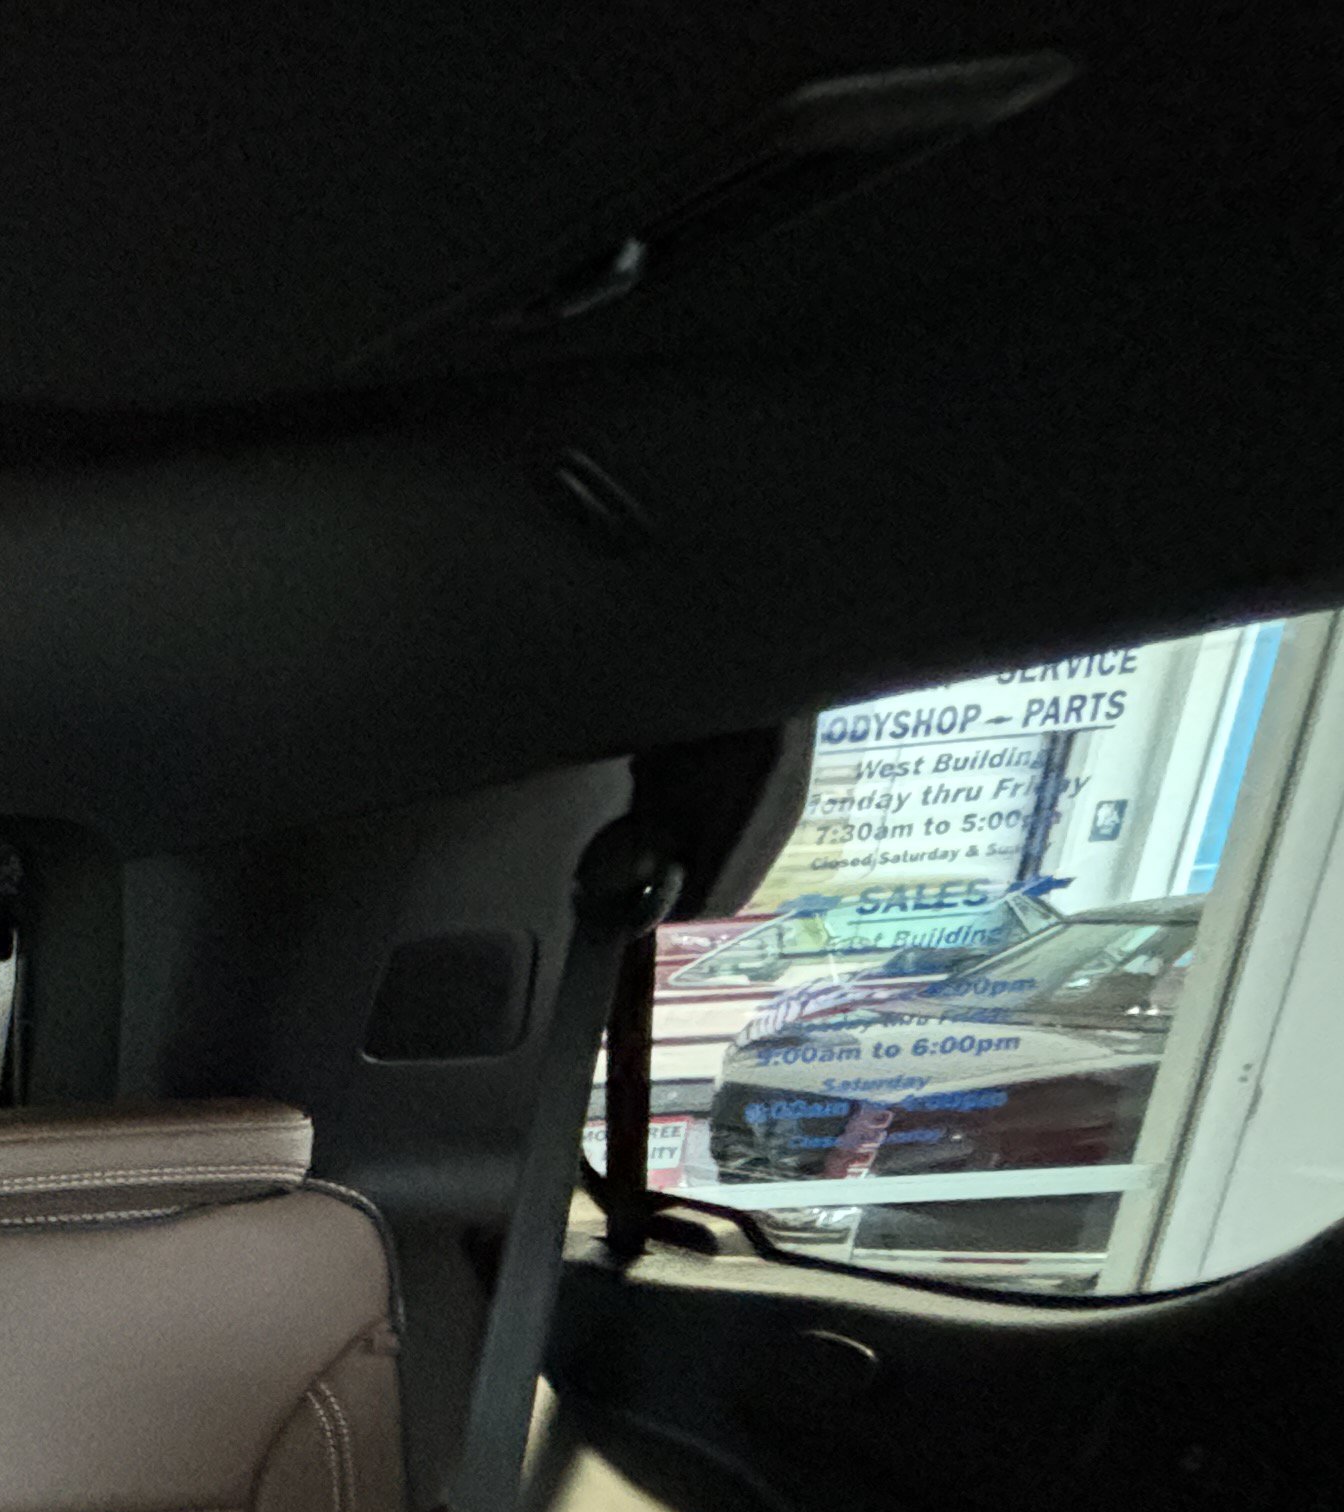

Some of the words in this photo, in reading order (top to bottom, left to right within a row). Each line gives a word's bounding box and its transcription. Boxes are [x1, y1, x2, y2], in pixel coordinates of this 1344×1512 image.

[821, 704, 982, 745] ODYSHOP
[1021, 690, 1127, 729] PARTS
[855, 756, 925, 780] West
[921, 781, 984, 806] thru
[992, 774, 1092, 800] Friy
[815, 821, 914, 846] 7:30am
[923, 816, 951, 837] to
[962, 808, 1063, 834] 5:00
[811, 853, 874, 872] Closed
[878, 845, 960, 866] Saturday
[855, 878, 991, 915] SALES
[756, 1043, 861, 1067] 9:00am
[872, 1041, 902, 1060] to
[912, 1033, 1022, 1058] 6:00pm
